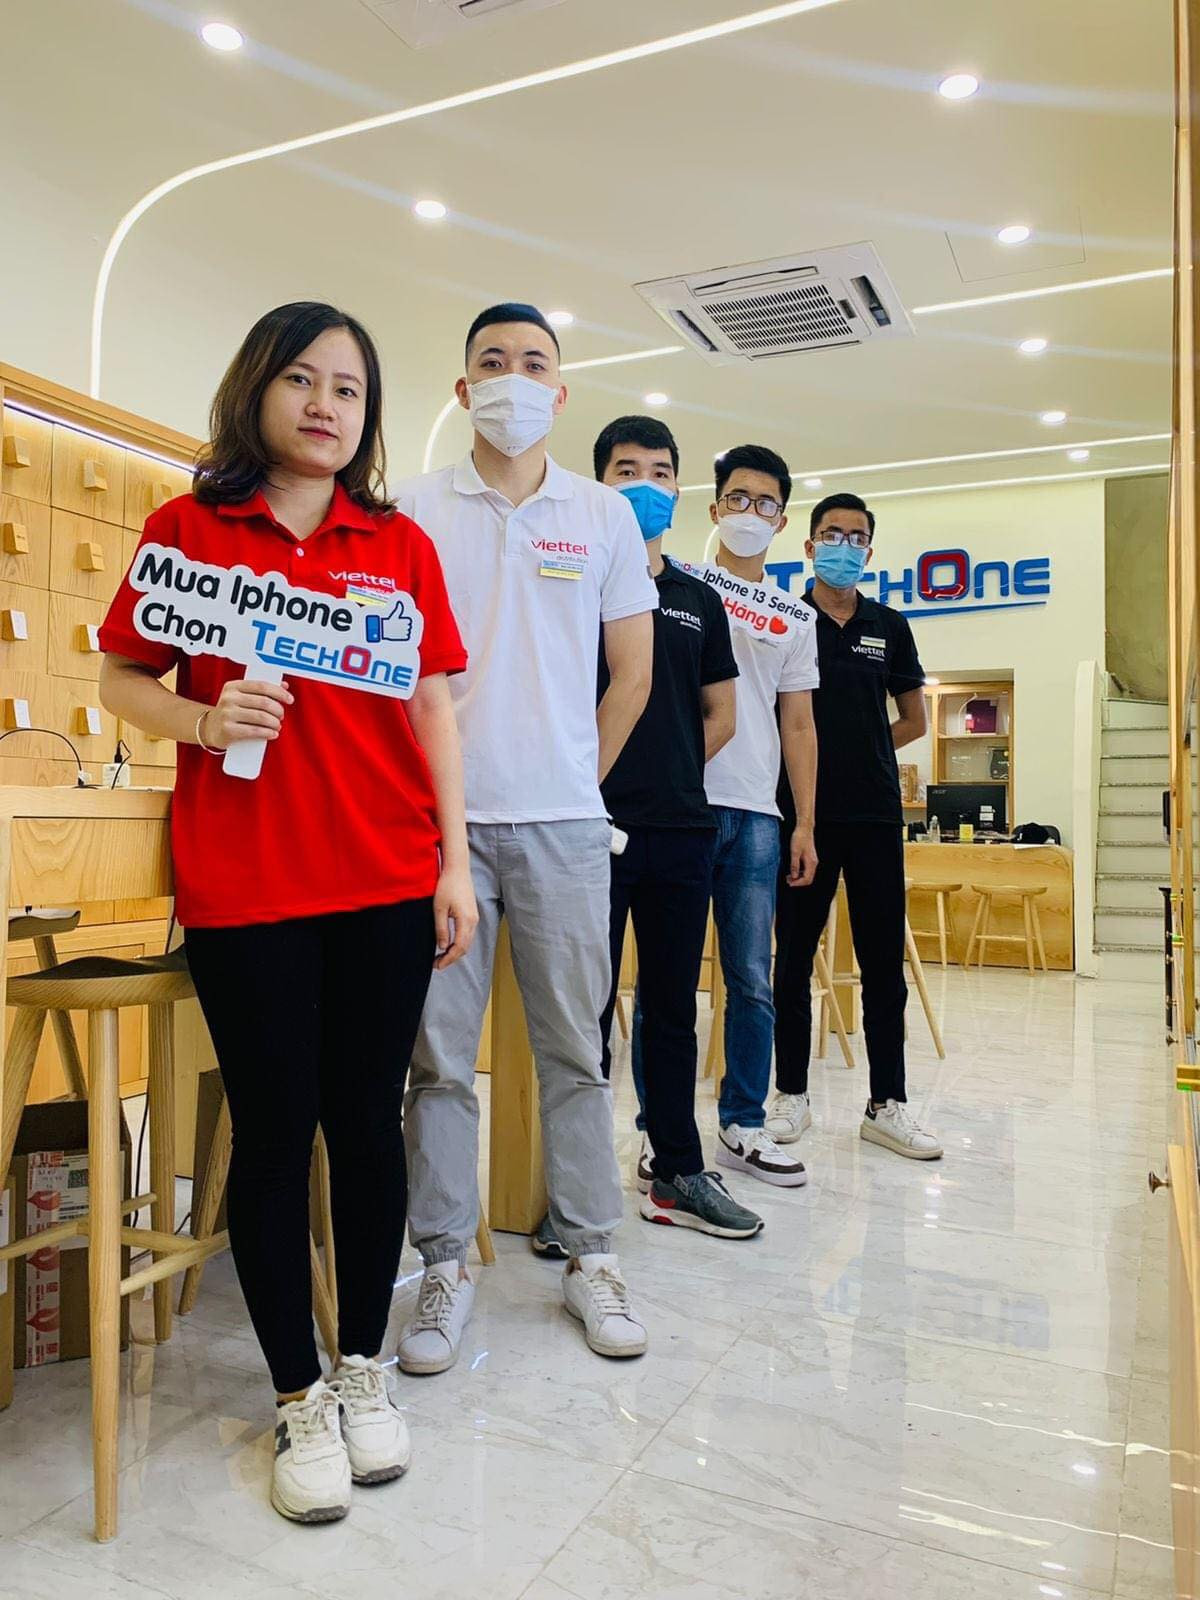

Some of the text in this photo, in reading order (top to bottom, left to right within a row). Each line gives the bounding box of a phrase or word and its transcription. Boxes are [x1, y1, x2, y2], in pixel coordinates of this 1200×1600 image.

[531, 539, 589, 556] viettel
[137, 553, 353, 632] Mua Iphone
[327, 568, 397, 592] viettel
[703, 569, 749, 597] Iphone
[752, 588, 767, 604] 13
[768, 596, 810, 622] Series
[141, 602, 227, 647] Chọn
[661, 607, 703, 627] viettel
